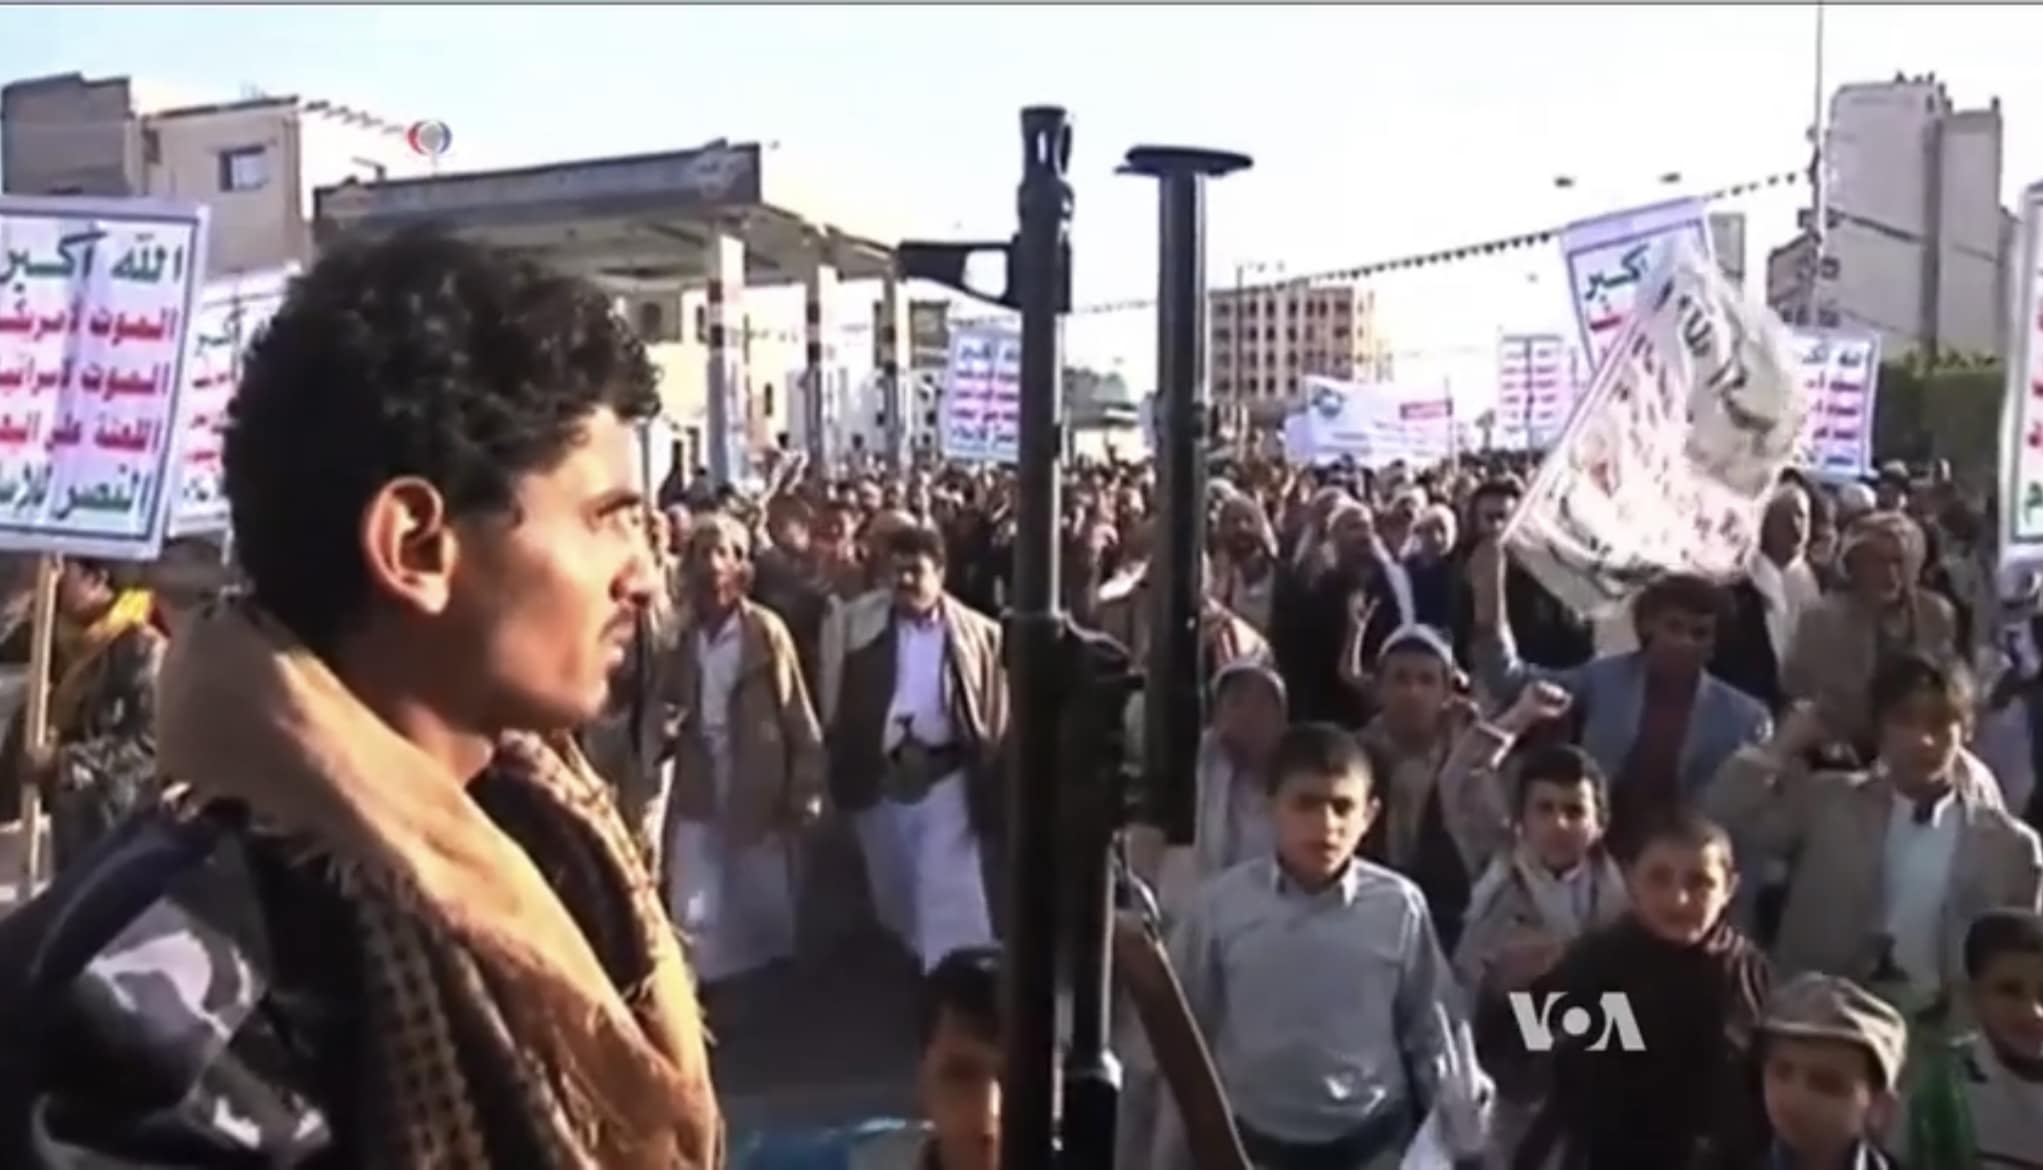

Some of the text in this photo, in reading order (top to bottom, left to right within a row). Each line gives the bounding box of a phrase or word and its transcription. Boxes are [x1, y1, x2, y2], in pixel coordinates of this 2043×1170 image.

[111, 232, 184, 284] الله
[90, 306, 179, 347] الموت
[82, 353, 170, 402] الموت
[53, 462, 152, 522] النصر
